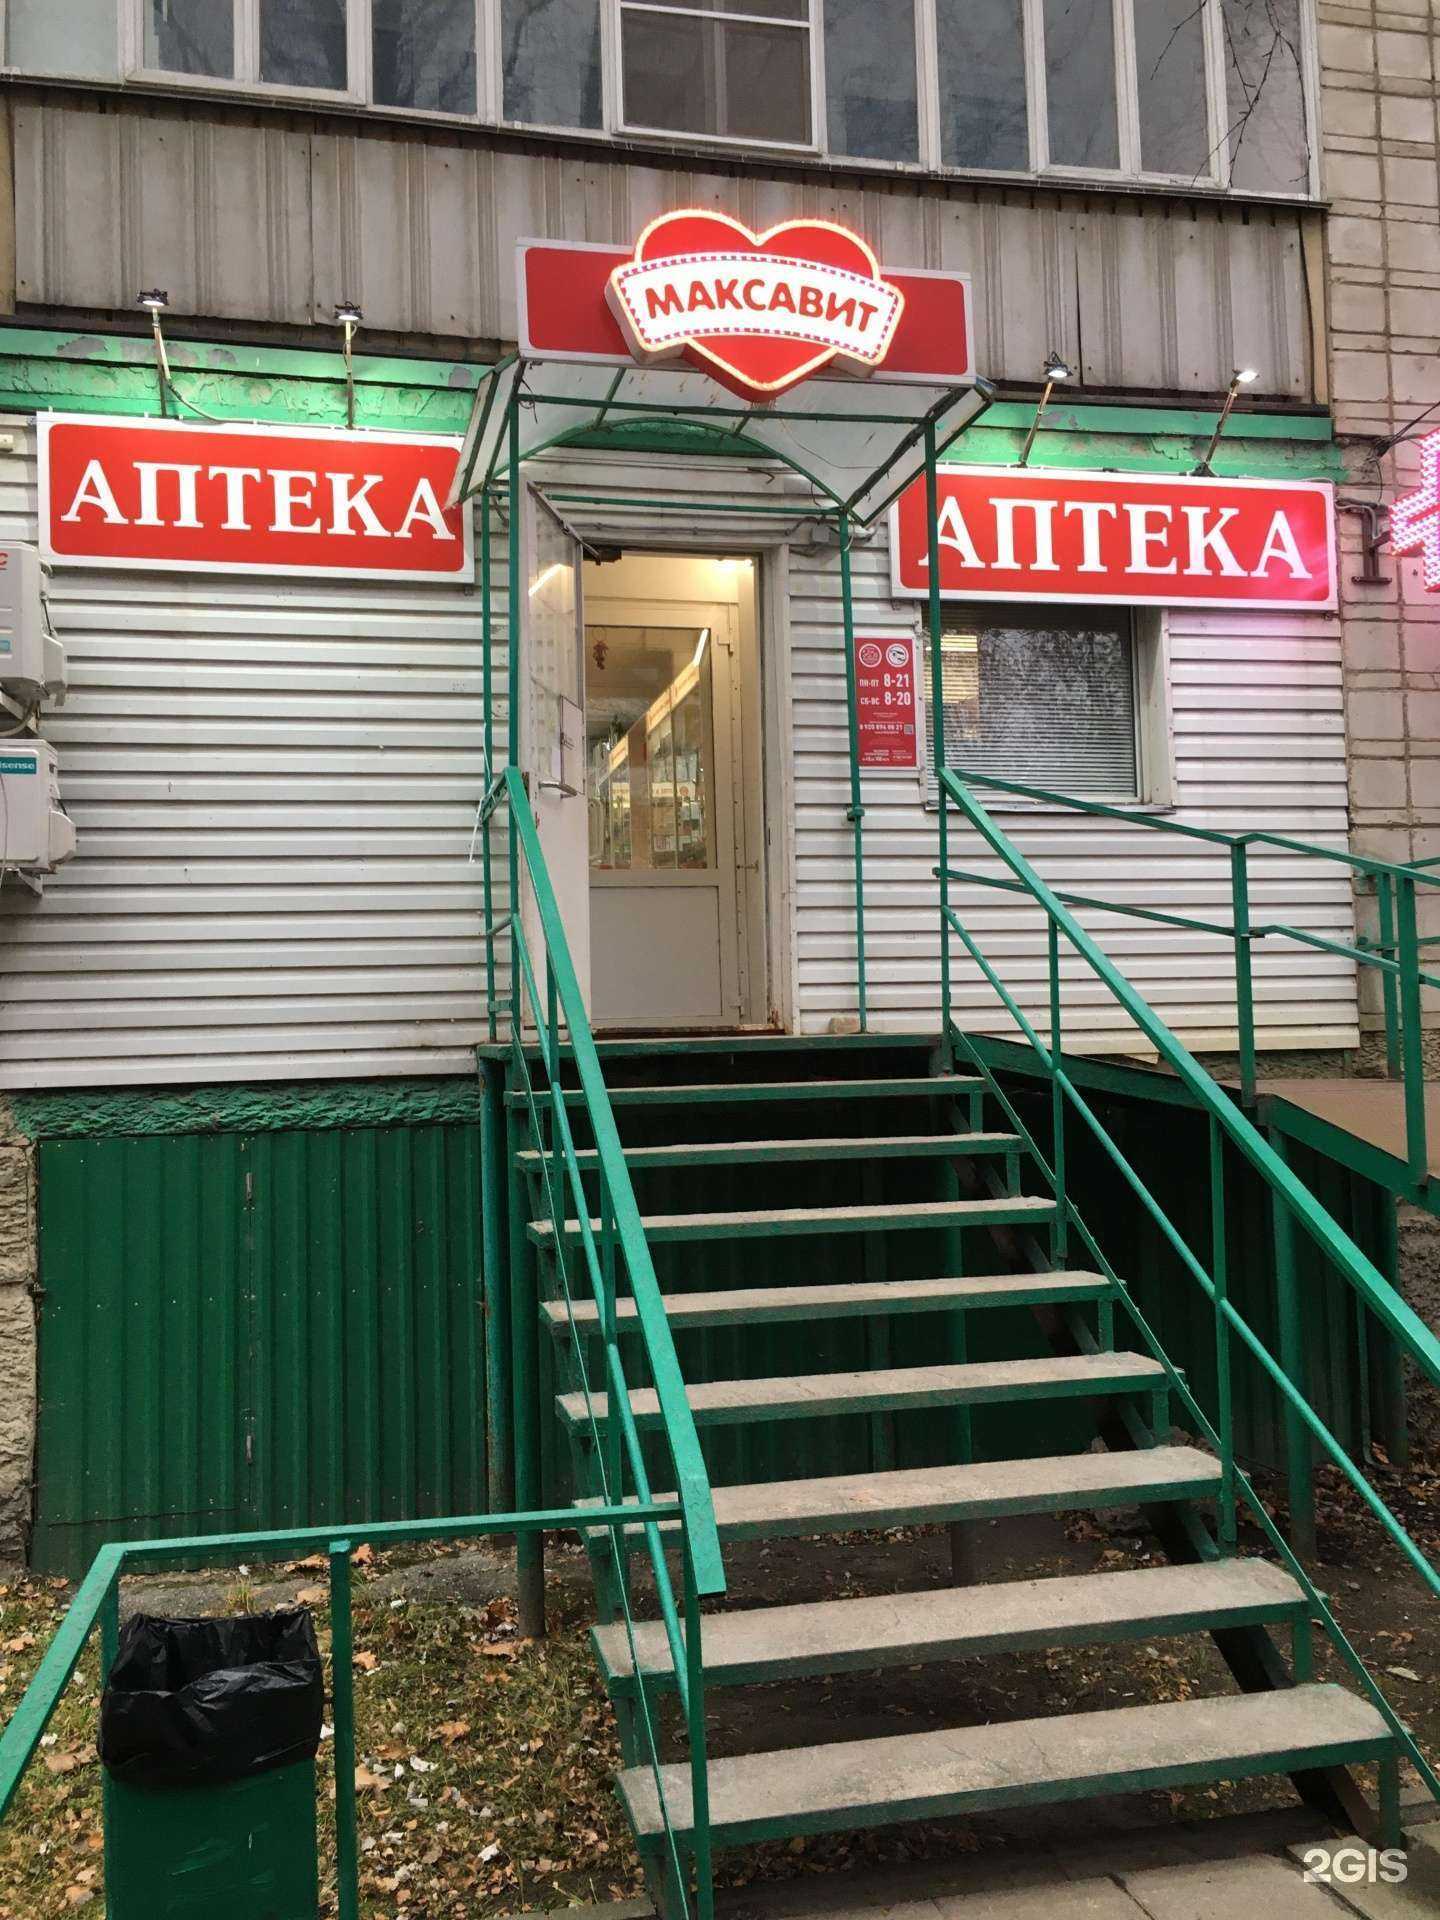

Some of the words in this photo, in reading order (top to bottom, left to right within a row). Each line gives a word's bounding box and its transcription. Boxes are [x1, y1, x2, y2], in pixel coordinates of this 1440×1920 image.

[645, 278, 878, 332] МАКСАВИТ
[60, 459, 456, 541] АПТЕКА
[917, 495, 1313, 579] АПТЕКА
[884, 673, 909, 687] 8-21
[885, 691, 910, 705] 8-20
